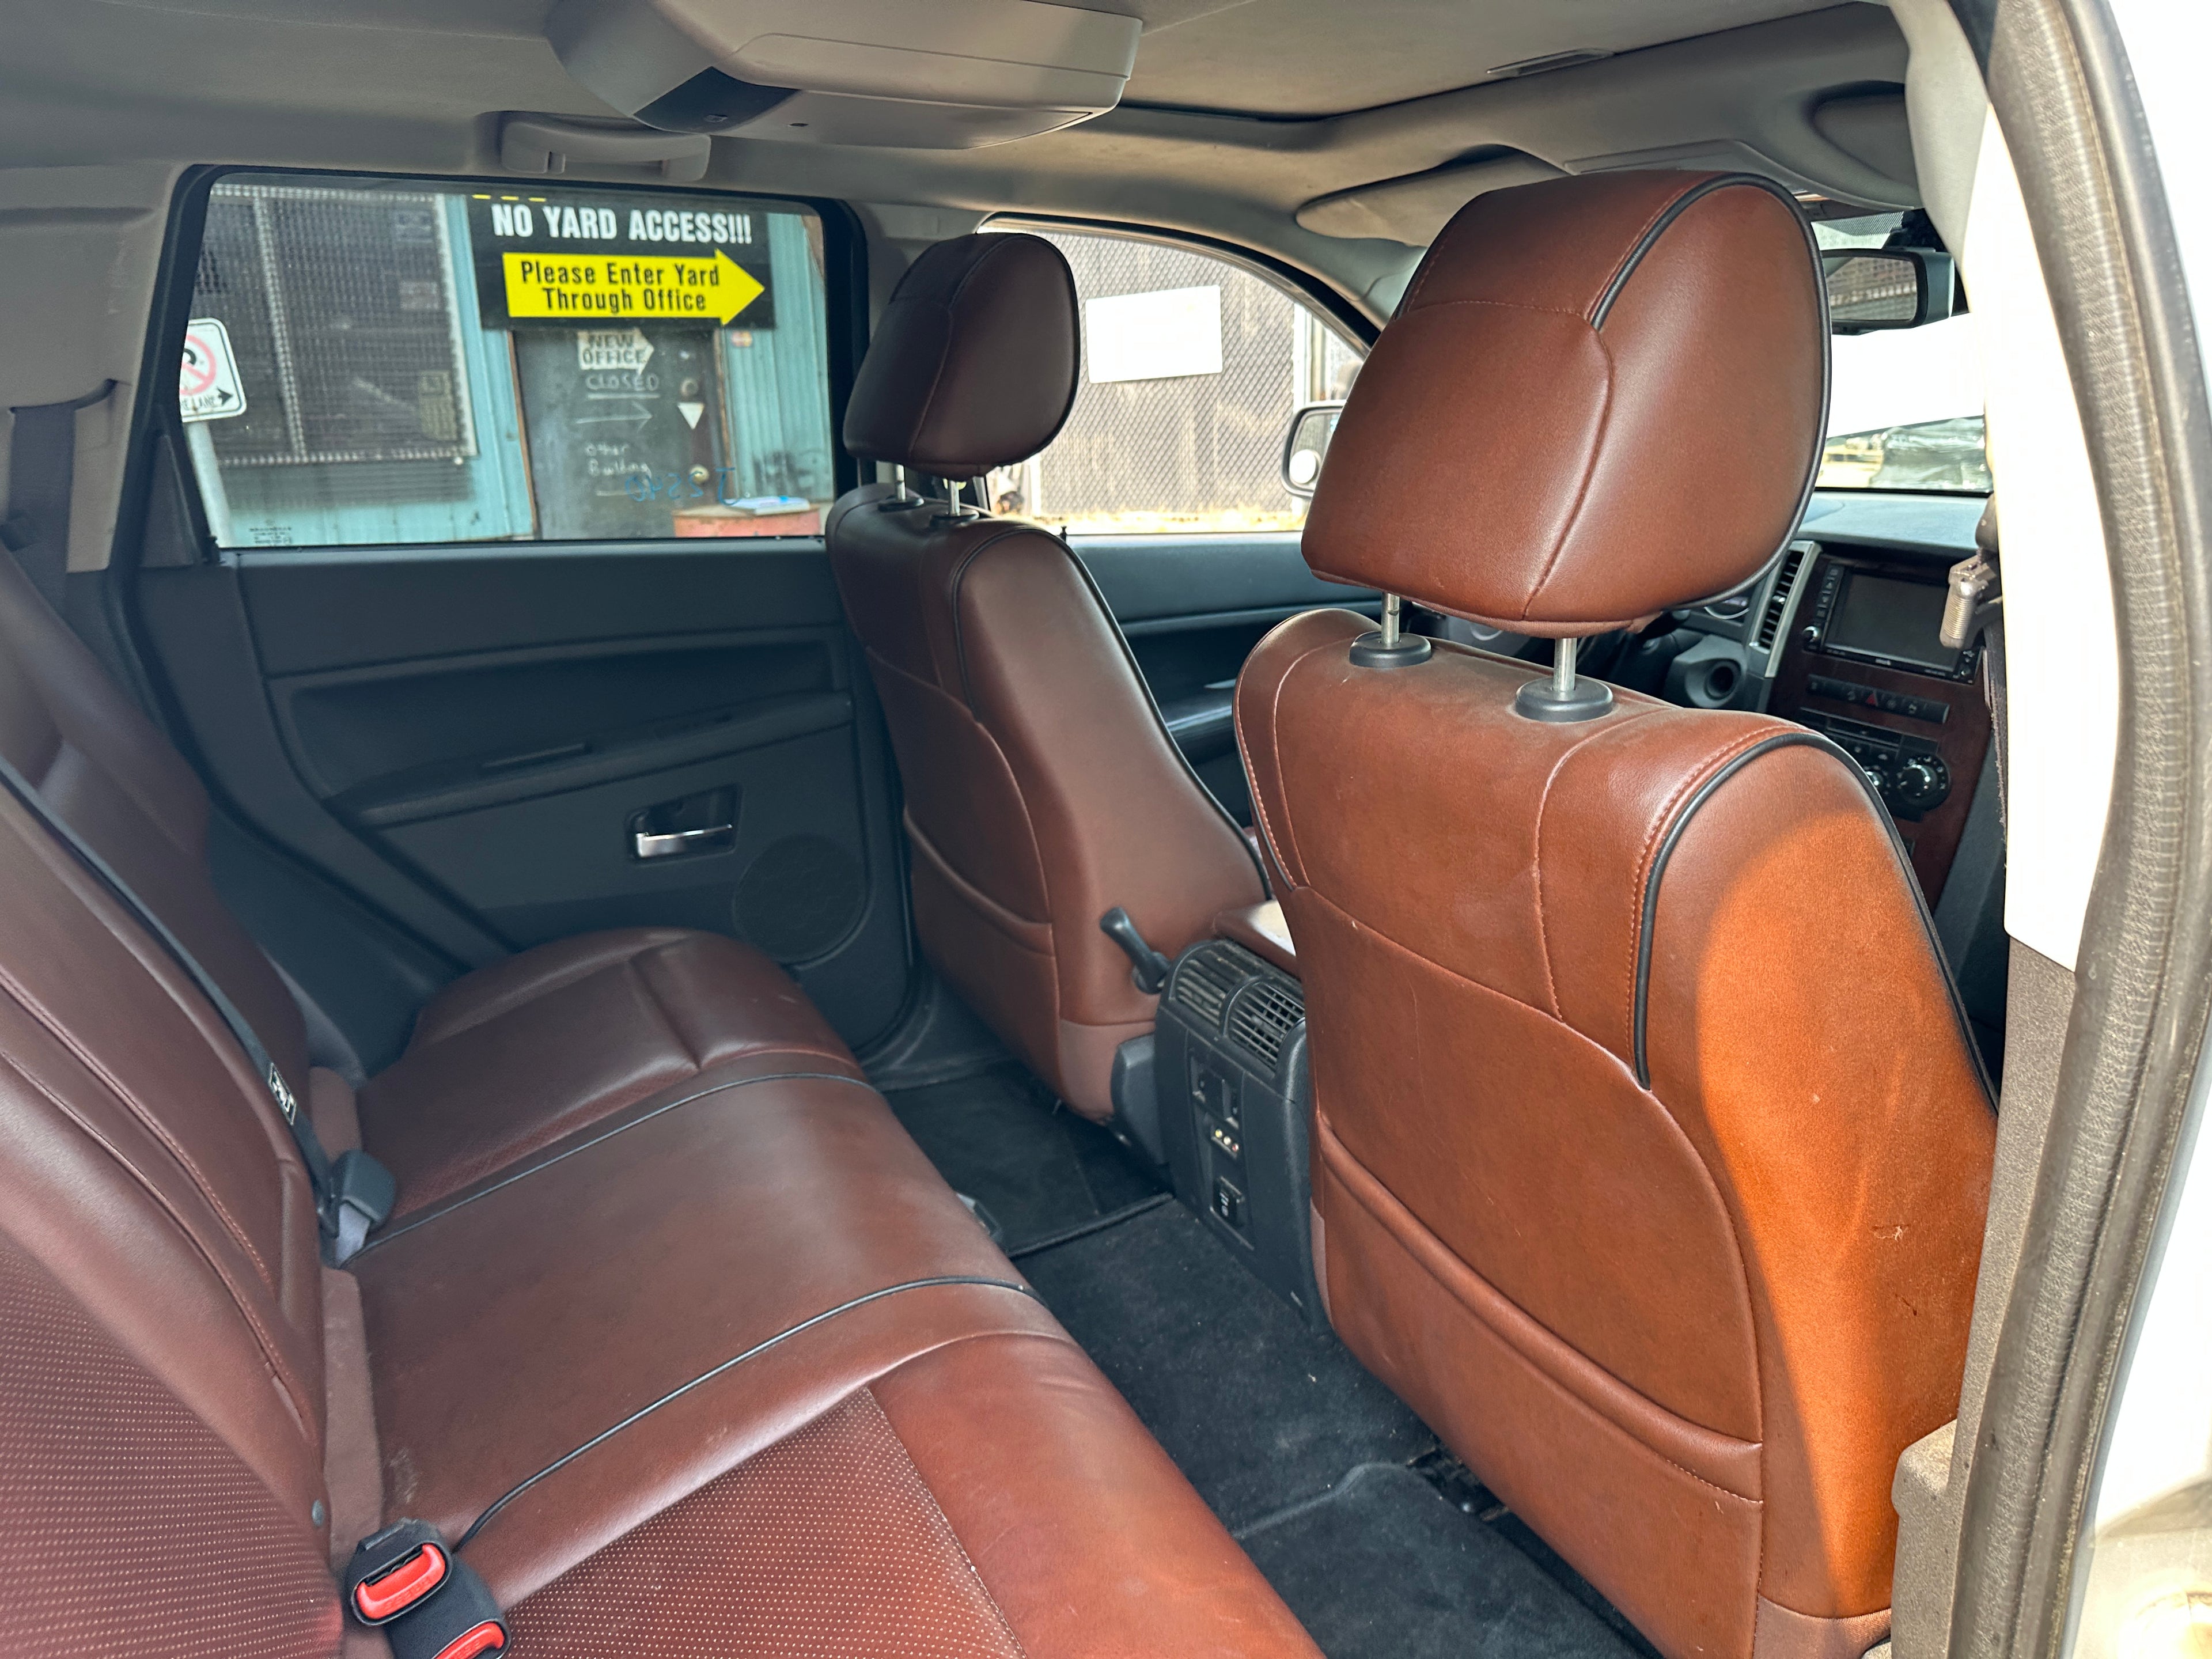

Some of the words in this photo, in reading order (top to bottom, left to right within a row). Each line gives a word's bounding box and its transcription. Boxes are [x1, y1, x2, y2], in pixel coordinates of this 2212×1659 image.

[491, 203, 533, 237] NO
[543, 206, 618, 240] YARD
[628, 209, 752, 244] ACCESS!!!
[520, 260, 596, 285] Please
[607, 263, 664, 286] Enter
[675, 264, 720, 286] Yard
[542, 288, 632, 314] Through
[643, 289, 706, 310] Office
[589, 334, 634, 348] NEW
[582, 348, 646, 364] OFFICE
